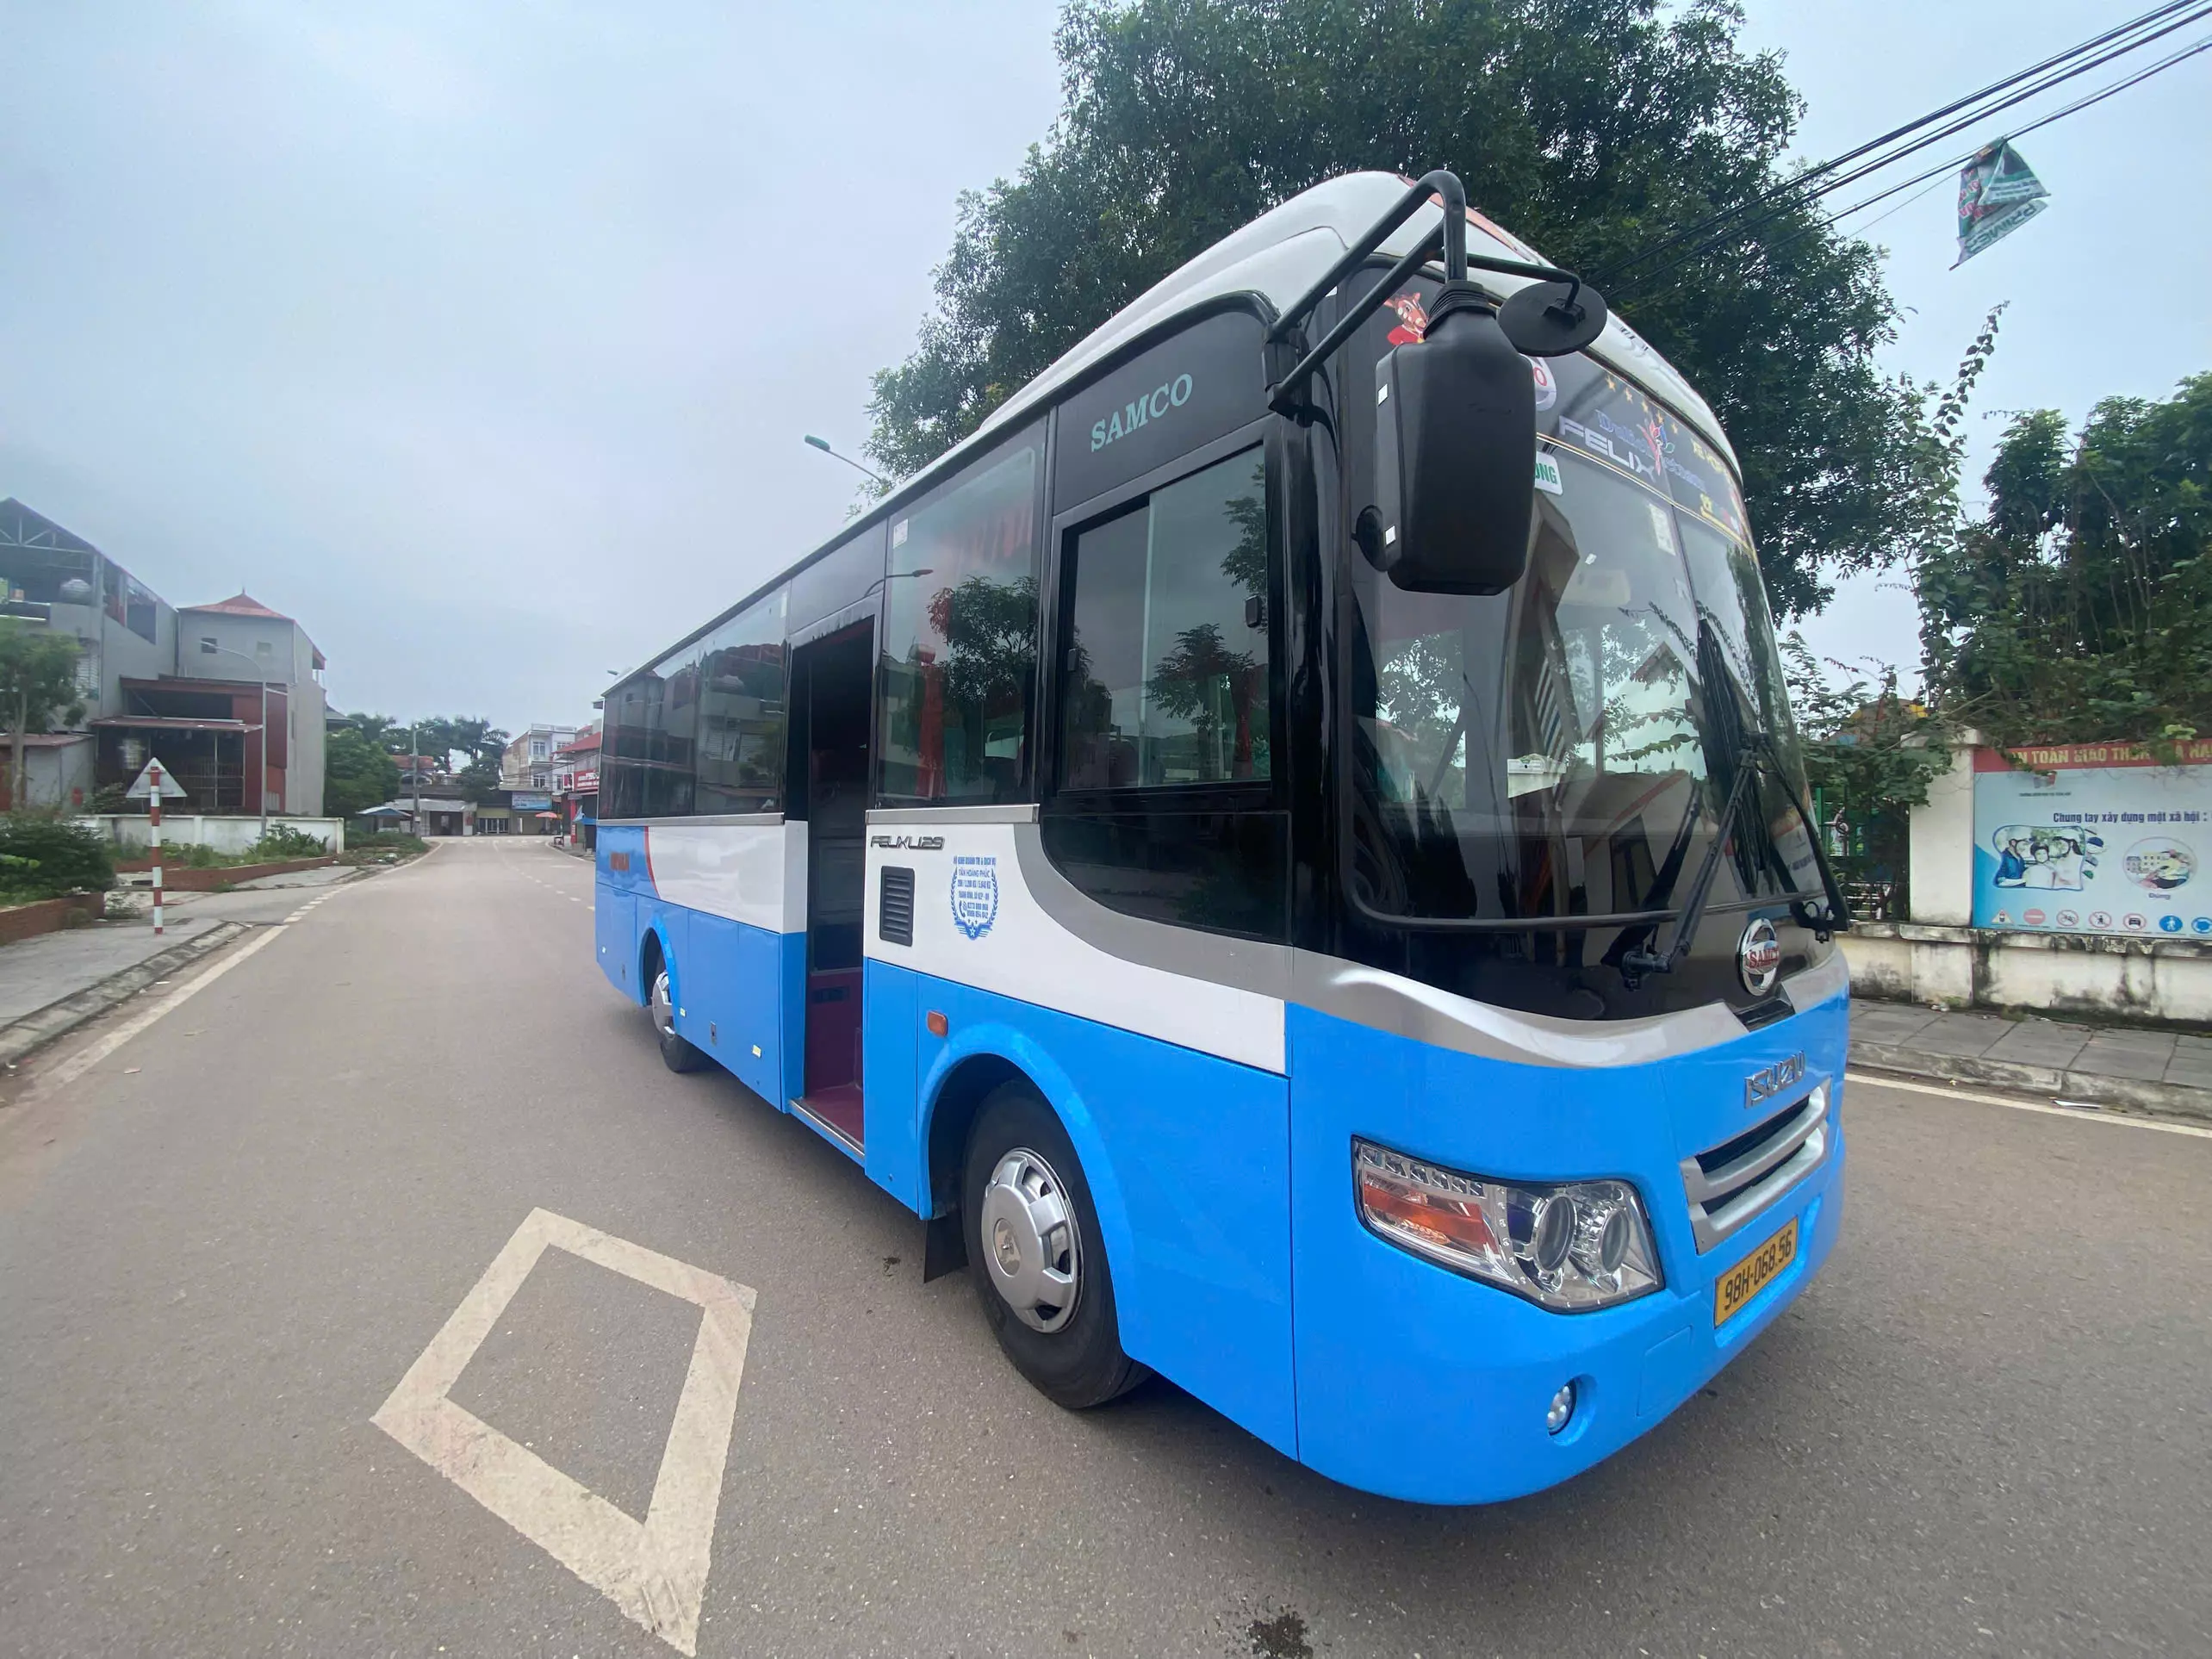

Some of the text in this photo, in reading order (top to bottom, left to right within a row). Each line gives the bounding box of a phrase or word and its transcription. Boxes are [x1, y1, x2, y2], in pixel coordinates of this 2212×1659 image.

[1090, 373, 1193, 453] SAMCO
[1558, 414, 1656, 483] FELIX
[2053, 812, 2082, 823] Chung
[2085, 812, 2099, 823] tay
[1744, 1049, 1805, 1109] ISUZU
